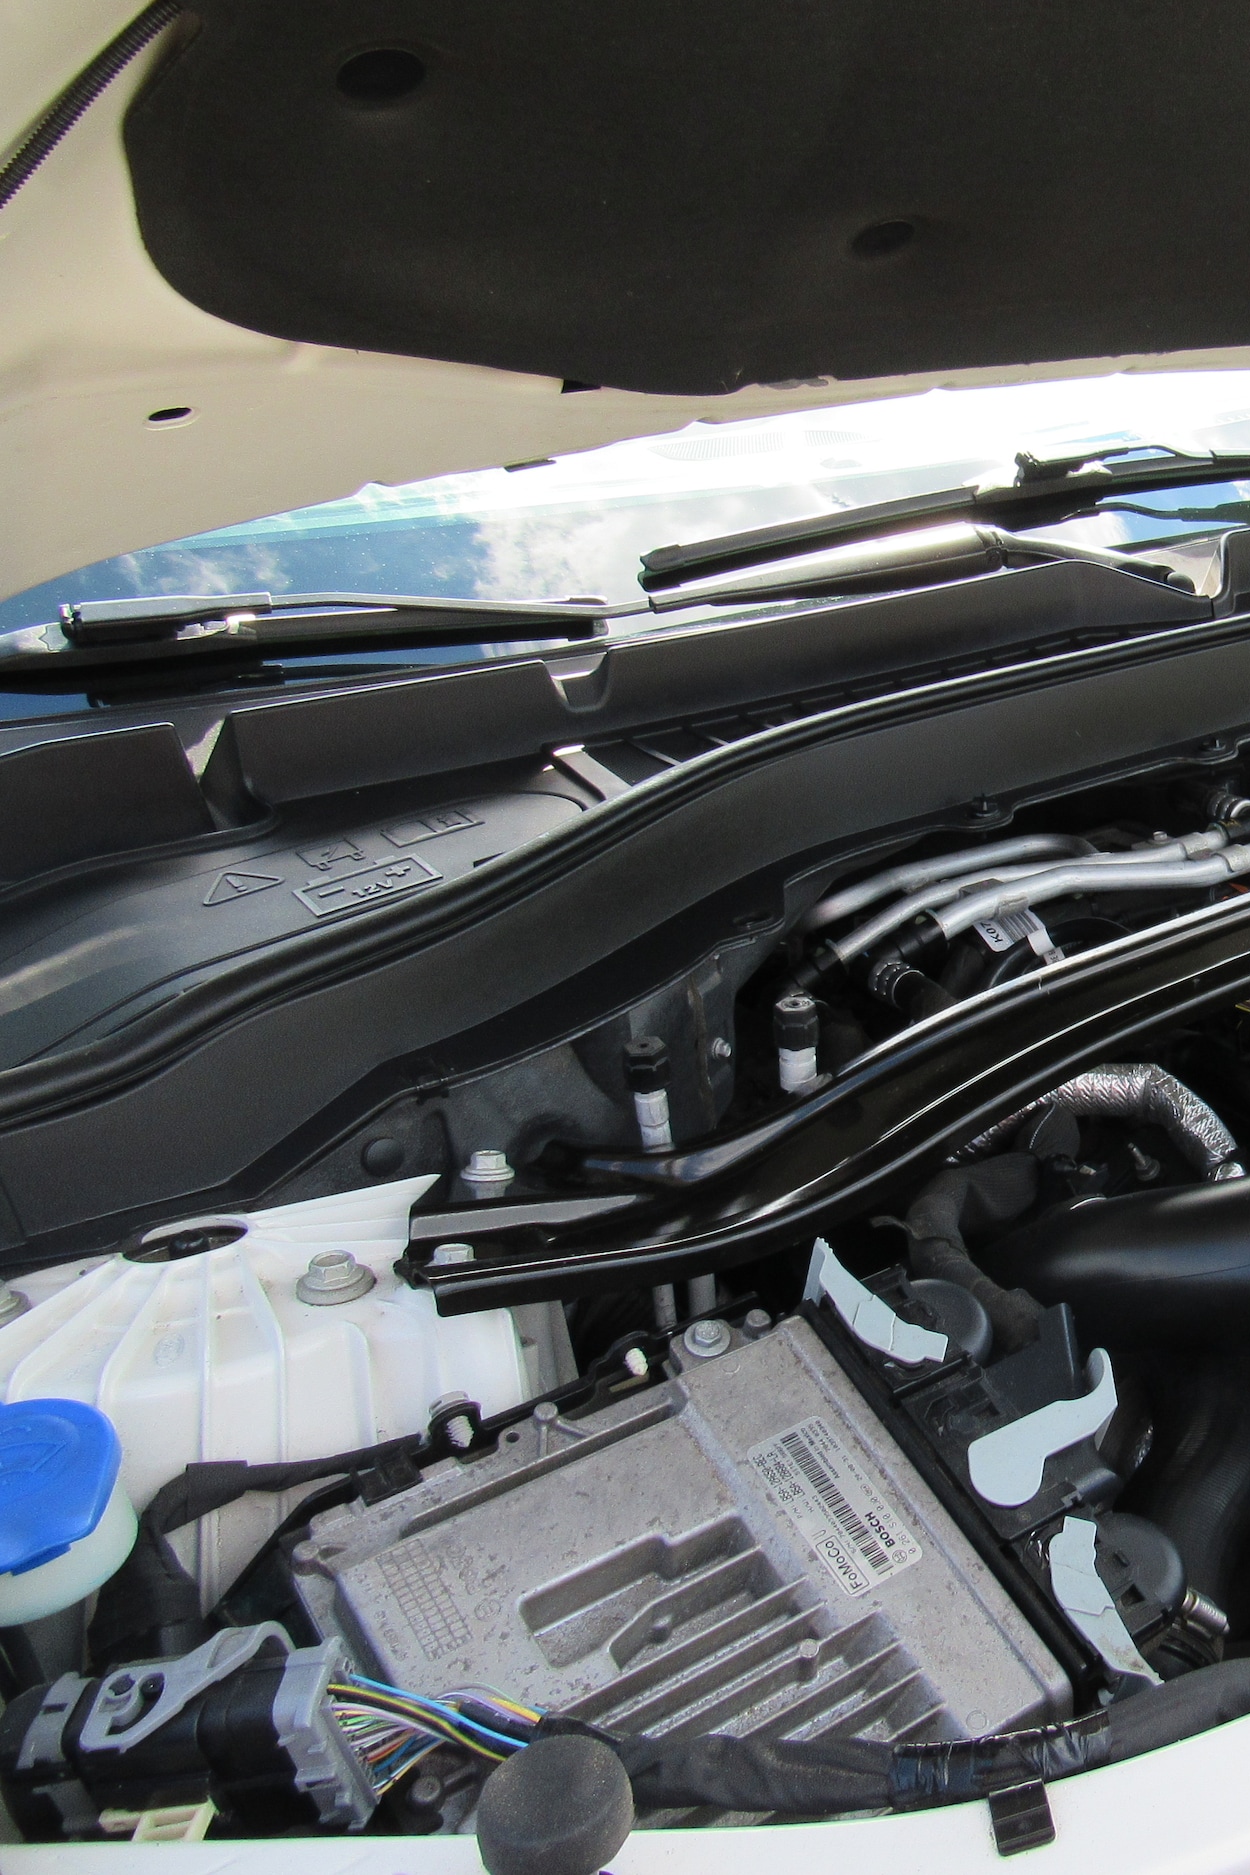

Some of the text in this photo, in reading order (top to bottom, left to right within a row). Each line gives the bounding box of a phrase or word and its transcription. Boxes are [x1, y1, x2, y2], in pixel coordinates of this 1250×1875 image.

[352, 879, 393, 897] 12V
[979, 921, 1003, 943] K07
[798, 1427, 816, 1446] Mexico
[816, 1450, 840, 1478] Assembled
[864, 1511, 896, 1547] BOSCH
[821, 1539, 864, 1589] FoMoCo
